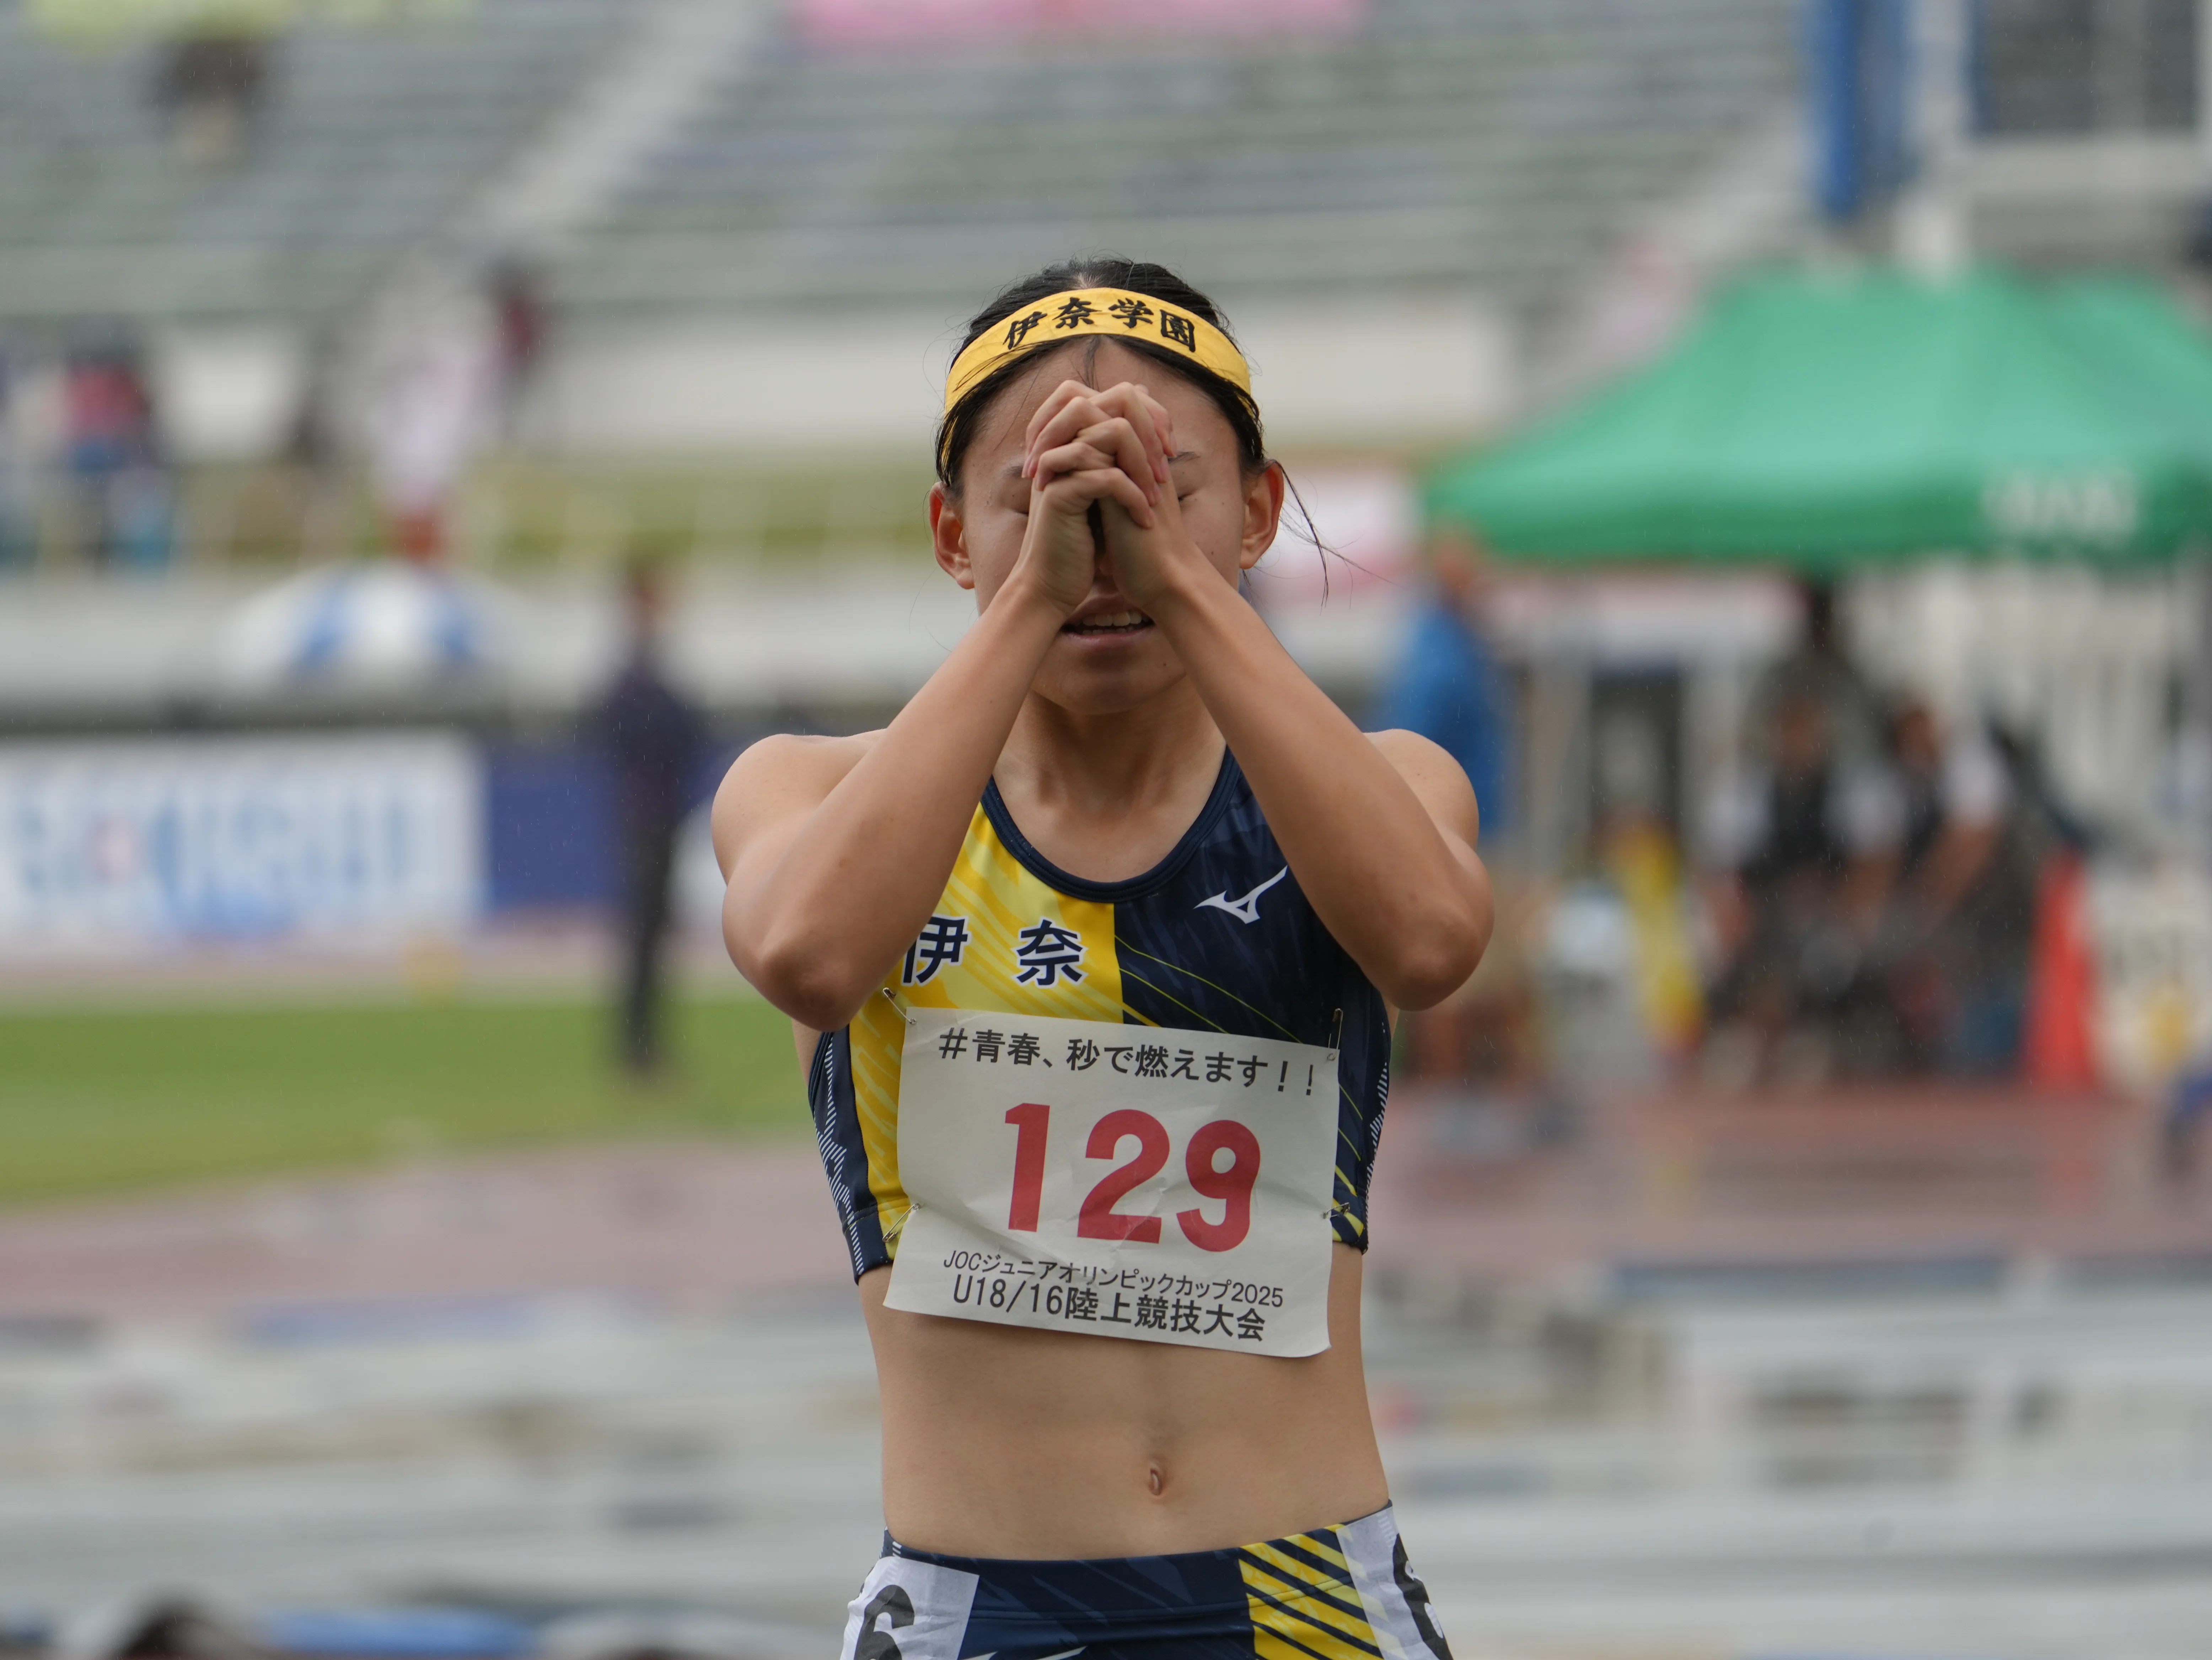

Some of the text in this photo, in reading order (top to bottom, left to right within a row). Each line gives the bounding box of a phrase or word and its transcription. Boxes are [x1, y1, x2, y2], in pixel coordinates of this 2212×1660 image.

[1003, 297, 1196, 352] 伊奈学園
[1005, 1103, 1261, 1252] 129
[944, 1250, 1283, 1308] JOCジュニアオリンピックカップ2025
[953, 1274, 1266, 1342] U18/16陸上競技大会
[854, 1584, 915, 1660] 6
